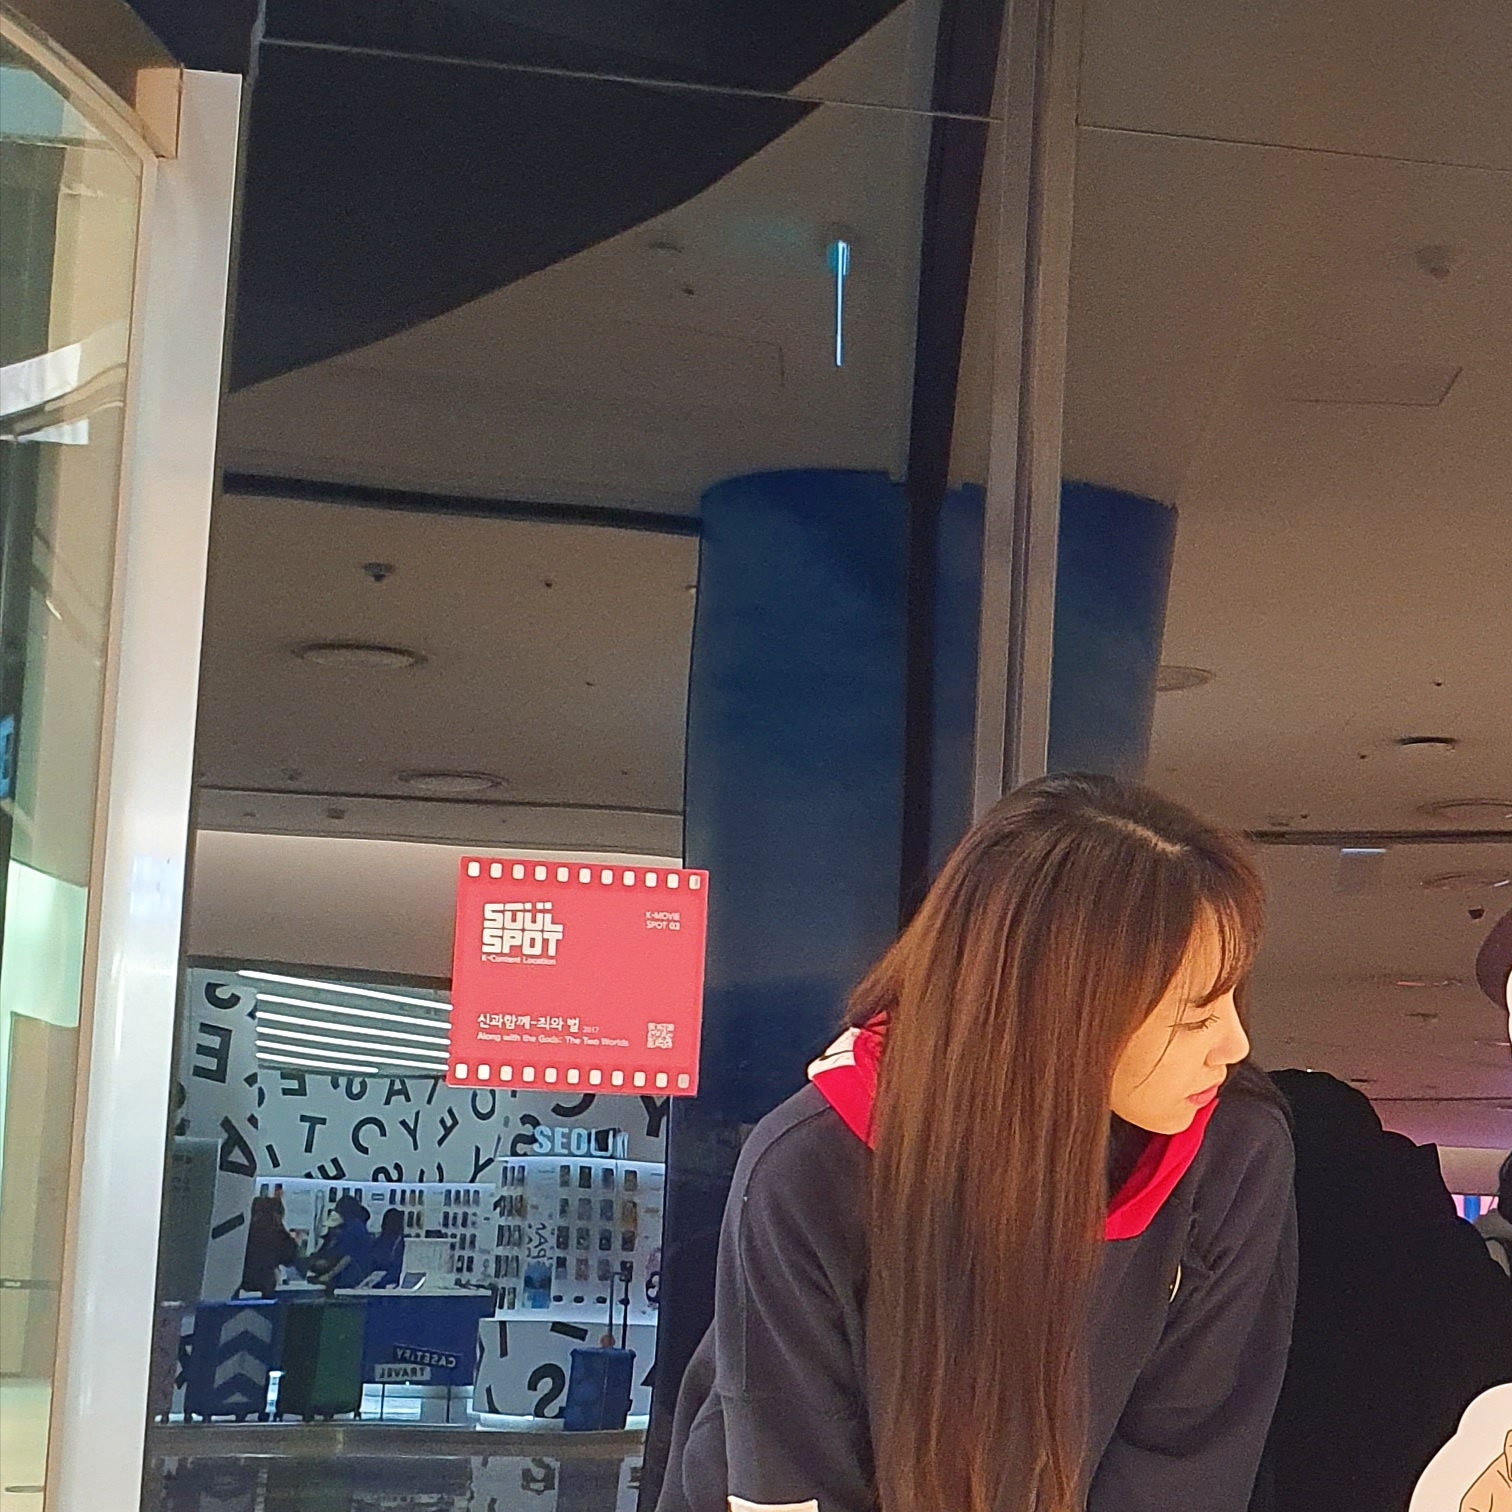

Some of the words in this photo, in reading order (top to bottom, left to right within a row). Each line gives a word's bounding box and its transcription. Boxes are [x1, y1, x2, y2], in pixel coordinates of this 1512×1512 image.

[481, 927, 563, 957] SPOT
[522, 956, 557, 966] Location
[477, 1013, 564, 1032] 신과함께-죄와
[567, 1017, 580, 1034] 벌
[477, 1031, 501, 1042] Along
[502, 1033, 521, 1042] with
[522, 1034, 537, 1043] the
[564, 1035, 581, 1045] The
[582, 1036, 600, 1046] Two
[601, 1037, 630, 1047] Worlds
